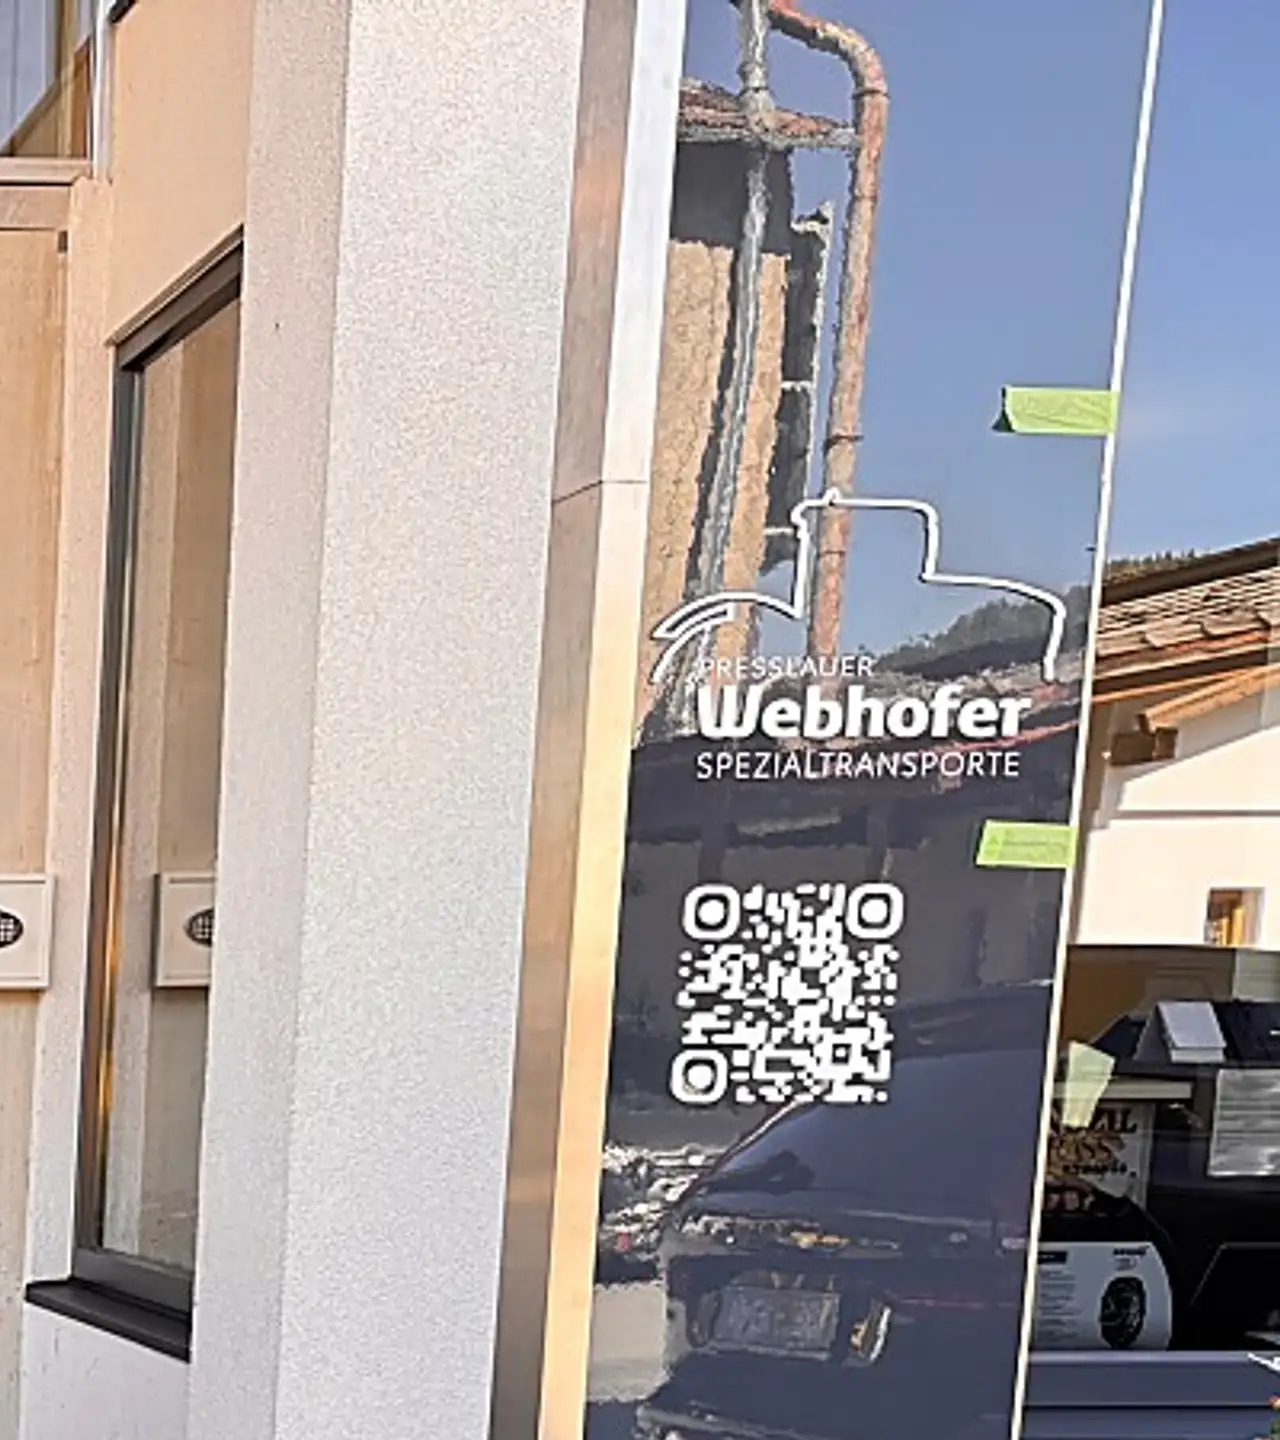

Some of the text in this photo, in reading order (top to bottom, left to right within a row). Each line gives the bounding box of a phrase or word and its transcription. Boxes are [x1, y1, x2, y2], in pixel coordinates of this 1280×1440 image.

[703, 655, 874, 680] PRESSLAUER
[696, 683, 1033, 740] Webhofer
[695, 751, 1022, 780] SPEZIALTRANSPORTE
